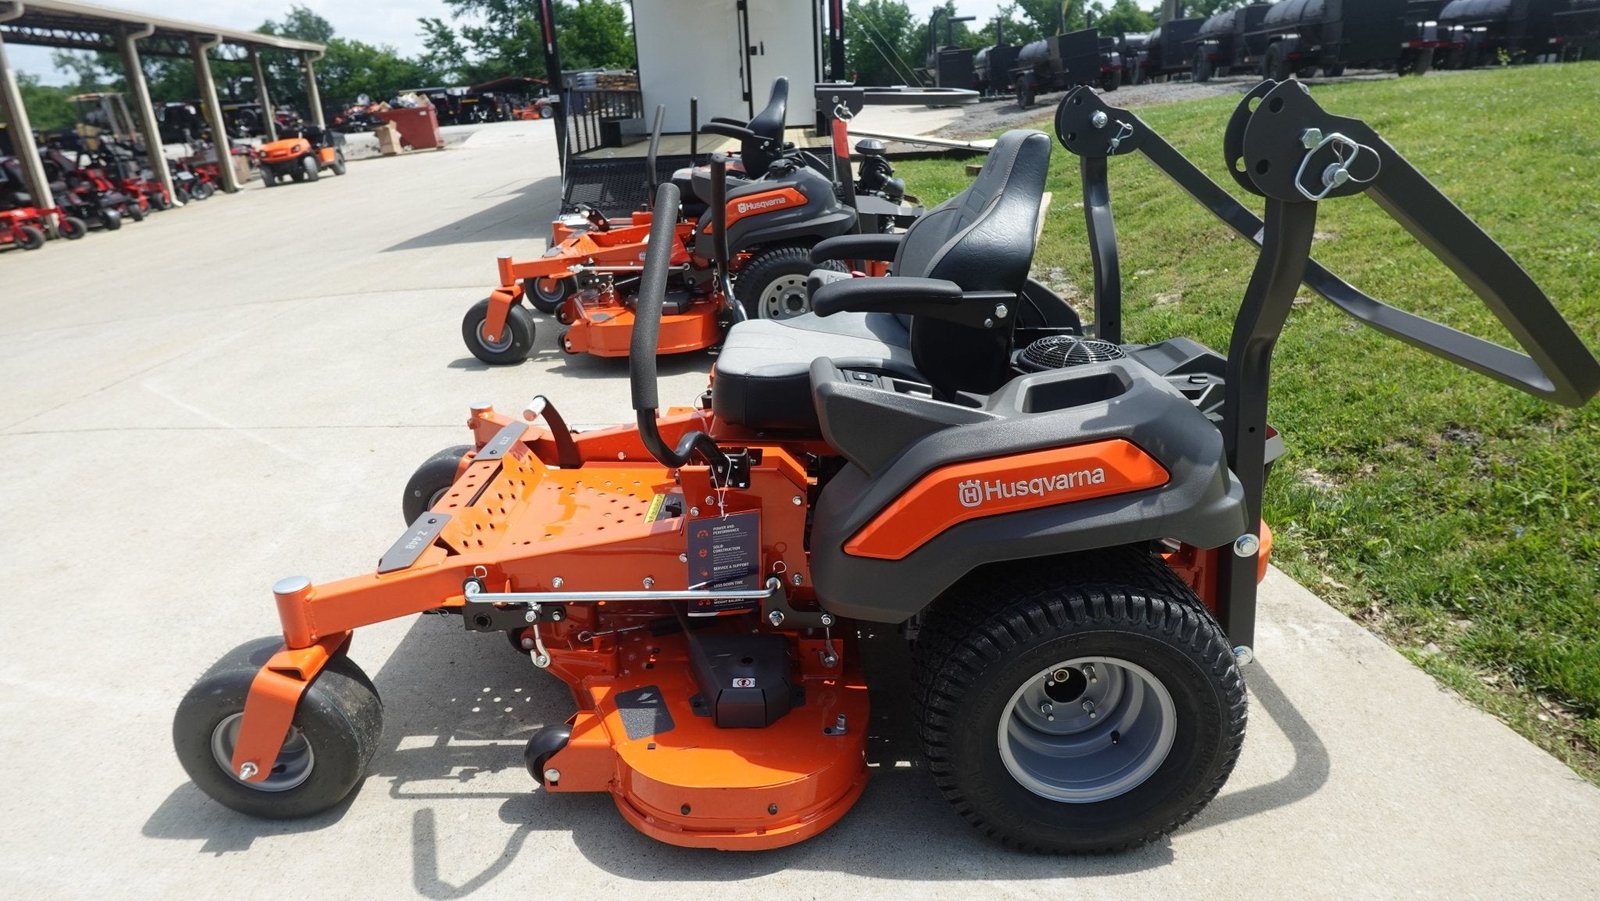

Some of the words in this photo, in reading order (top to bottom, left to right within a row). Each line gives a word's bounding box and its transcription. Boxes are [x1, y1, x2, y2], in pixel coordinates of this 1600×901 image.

[745, 197, 786, 211] Husqvarna
[984, 467, 1106, 501] Husqvarna
[713, 527, 740, 535] PERFORMANCE
